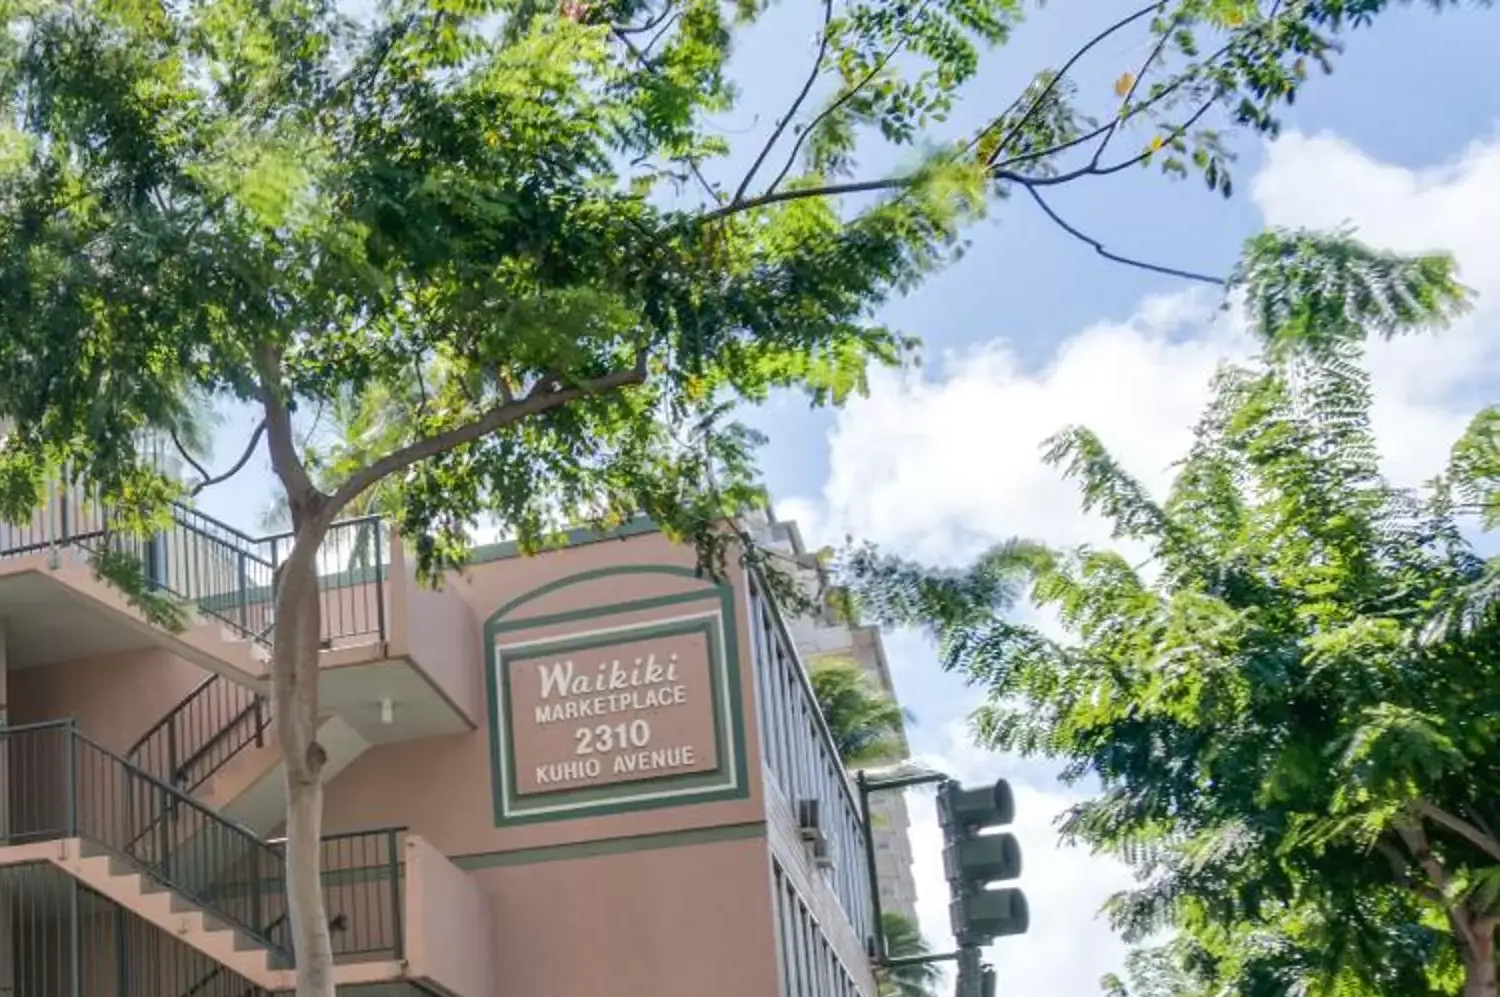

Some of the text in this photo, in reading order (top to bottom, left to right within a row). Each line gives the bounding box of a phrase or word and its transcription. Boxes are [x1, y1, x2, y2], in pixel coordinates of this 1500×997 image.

[538, 654, 679, 698] Waikiki
[535, 686, 687, 723] MARKETPLACE
[575, 720, 651, 755] 2310
[535, 747, 695, 784] KUHIO AVENUE
